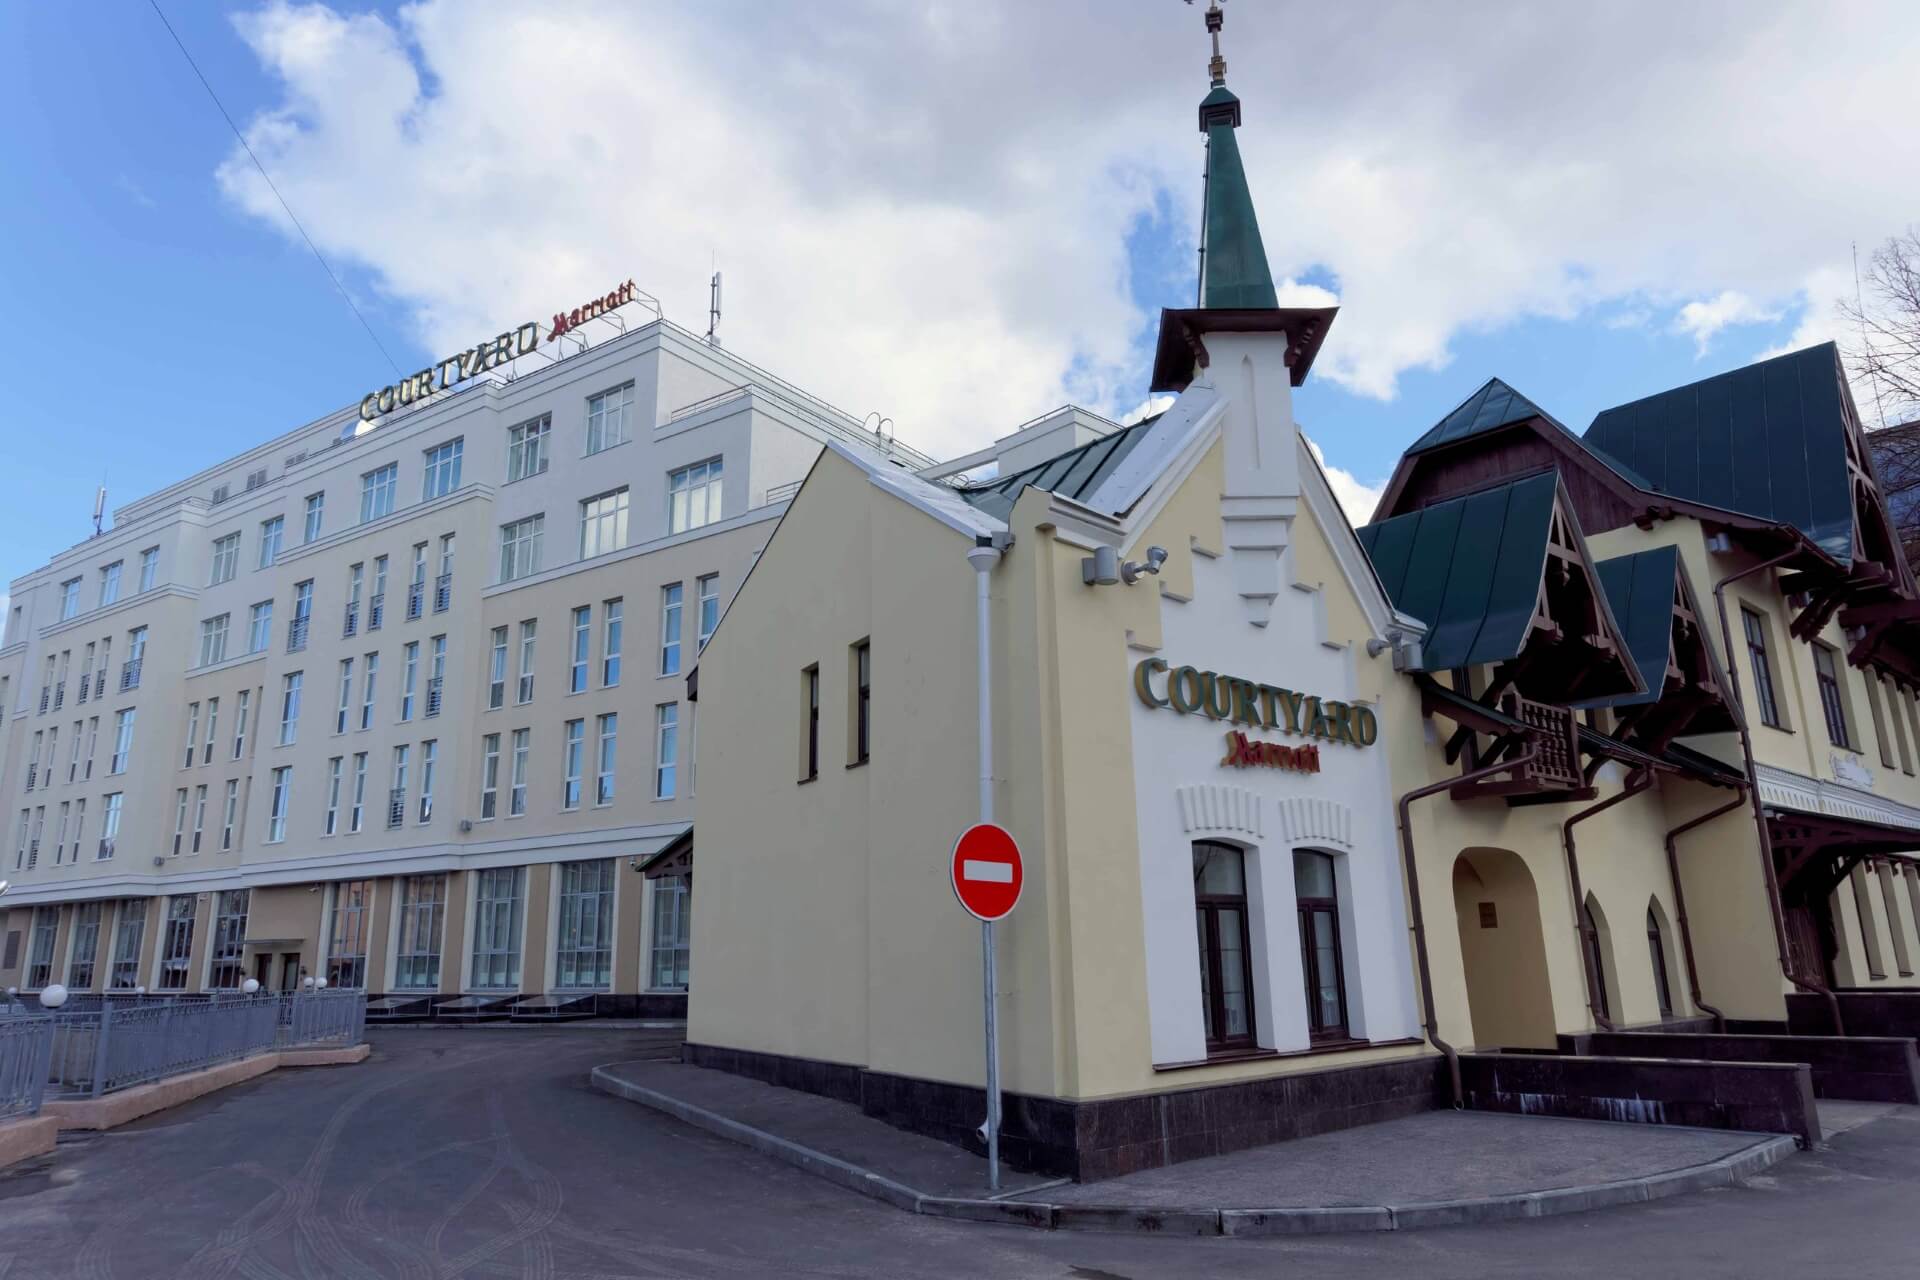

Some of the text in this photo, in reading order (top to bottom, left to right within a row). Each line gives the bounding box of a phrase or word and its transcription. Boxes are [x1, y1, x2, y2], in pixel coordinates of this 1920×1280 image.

[359, 278, 636, 421] COURTYARD Marriott
[1135, 657, 1377, 748] COURTYARD
[1220, 730, 1320, 773] Marriott
